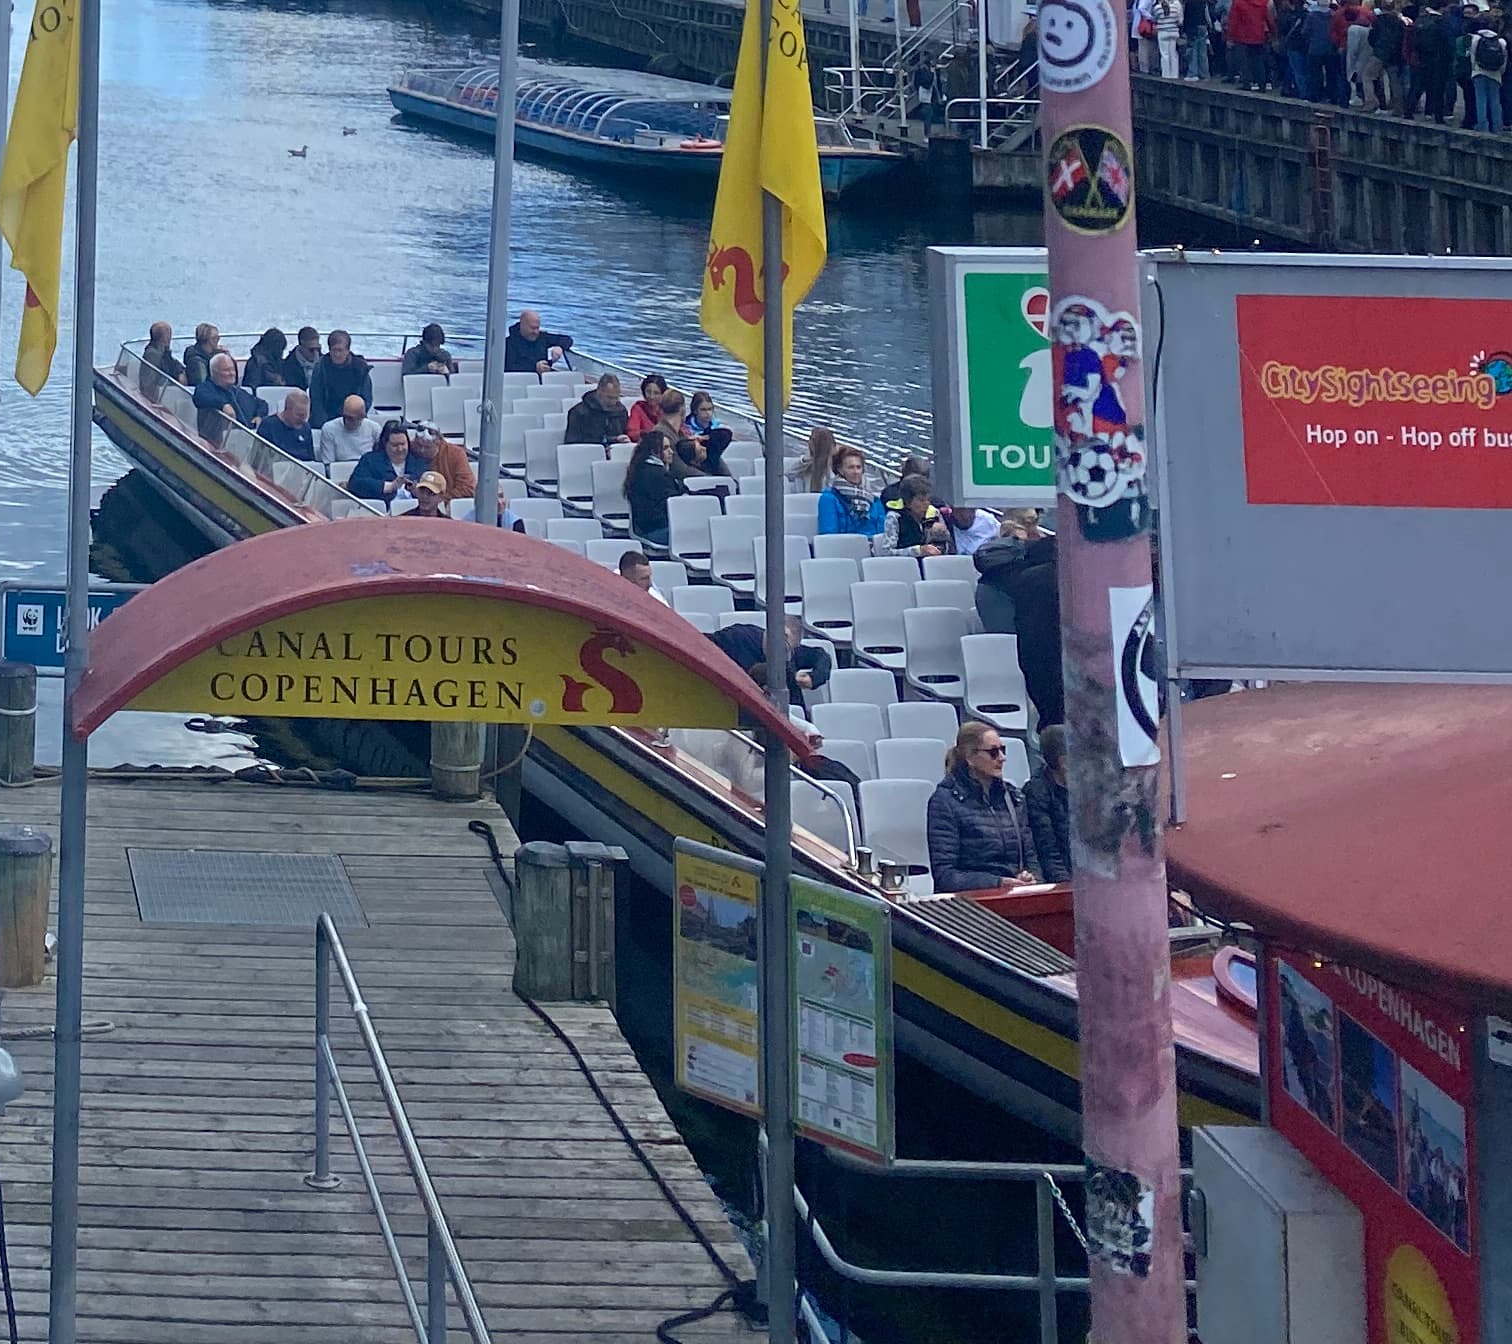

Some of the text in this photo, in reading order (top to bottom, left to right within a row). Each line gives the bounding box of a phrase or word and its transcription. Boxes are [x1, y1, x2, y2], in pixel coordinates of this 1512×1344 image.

[1261, 361, 1496, 410] CitySightseeing
[1305, 423, 1347, 449] Hop
[1354, 429, 1379, 445] on
[1401, 426, 1442, 450] Hop
[1448, 427, 1477, 447] off
[375, 632, 519, 666] TOURS
[209, 671, 526, 710] COPENHAGEN
